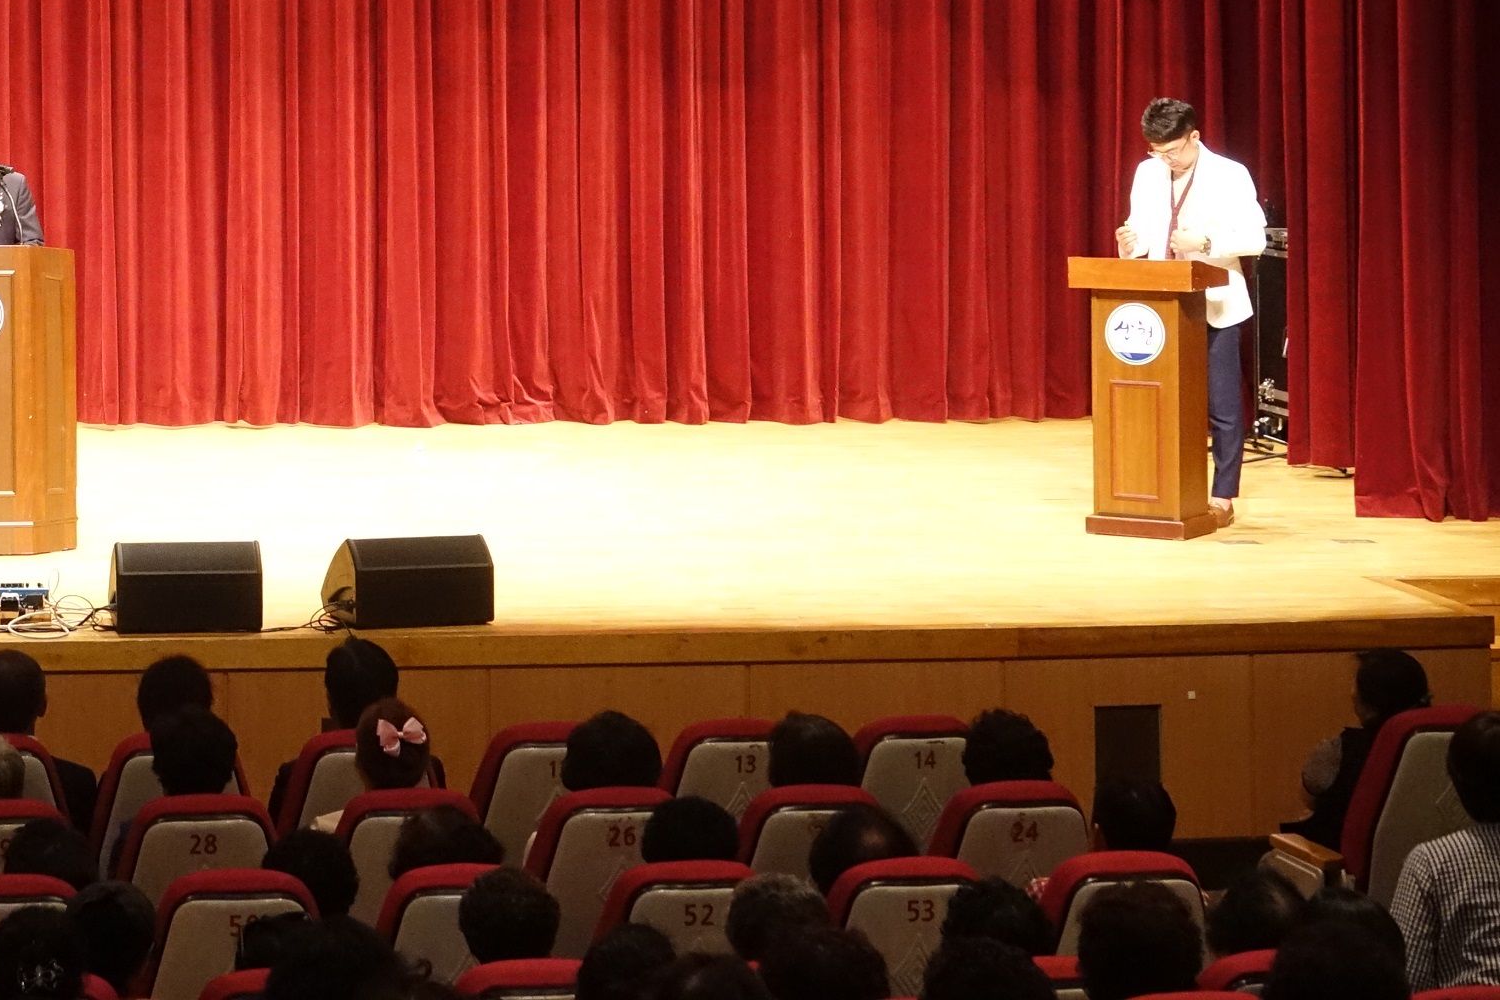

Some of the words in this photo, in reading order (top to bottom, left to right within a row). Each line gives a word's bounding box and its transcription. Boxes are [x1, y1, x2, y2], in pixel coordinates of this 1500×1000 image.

[735, 754, 757, 774] 13
[912, 750, 935, 770] 14
[606, 826, 637, 848] 26
[1011, 821, 1039, 843] 24
[190, 833, 218, 855] 28
[684, 903, 715, 926] 52
[907, 899, 936, 922] 53
